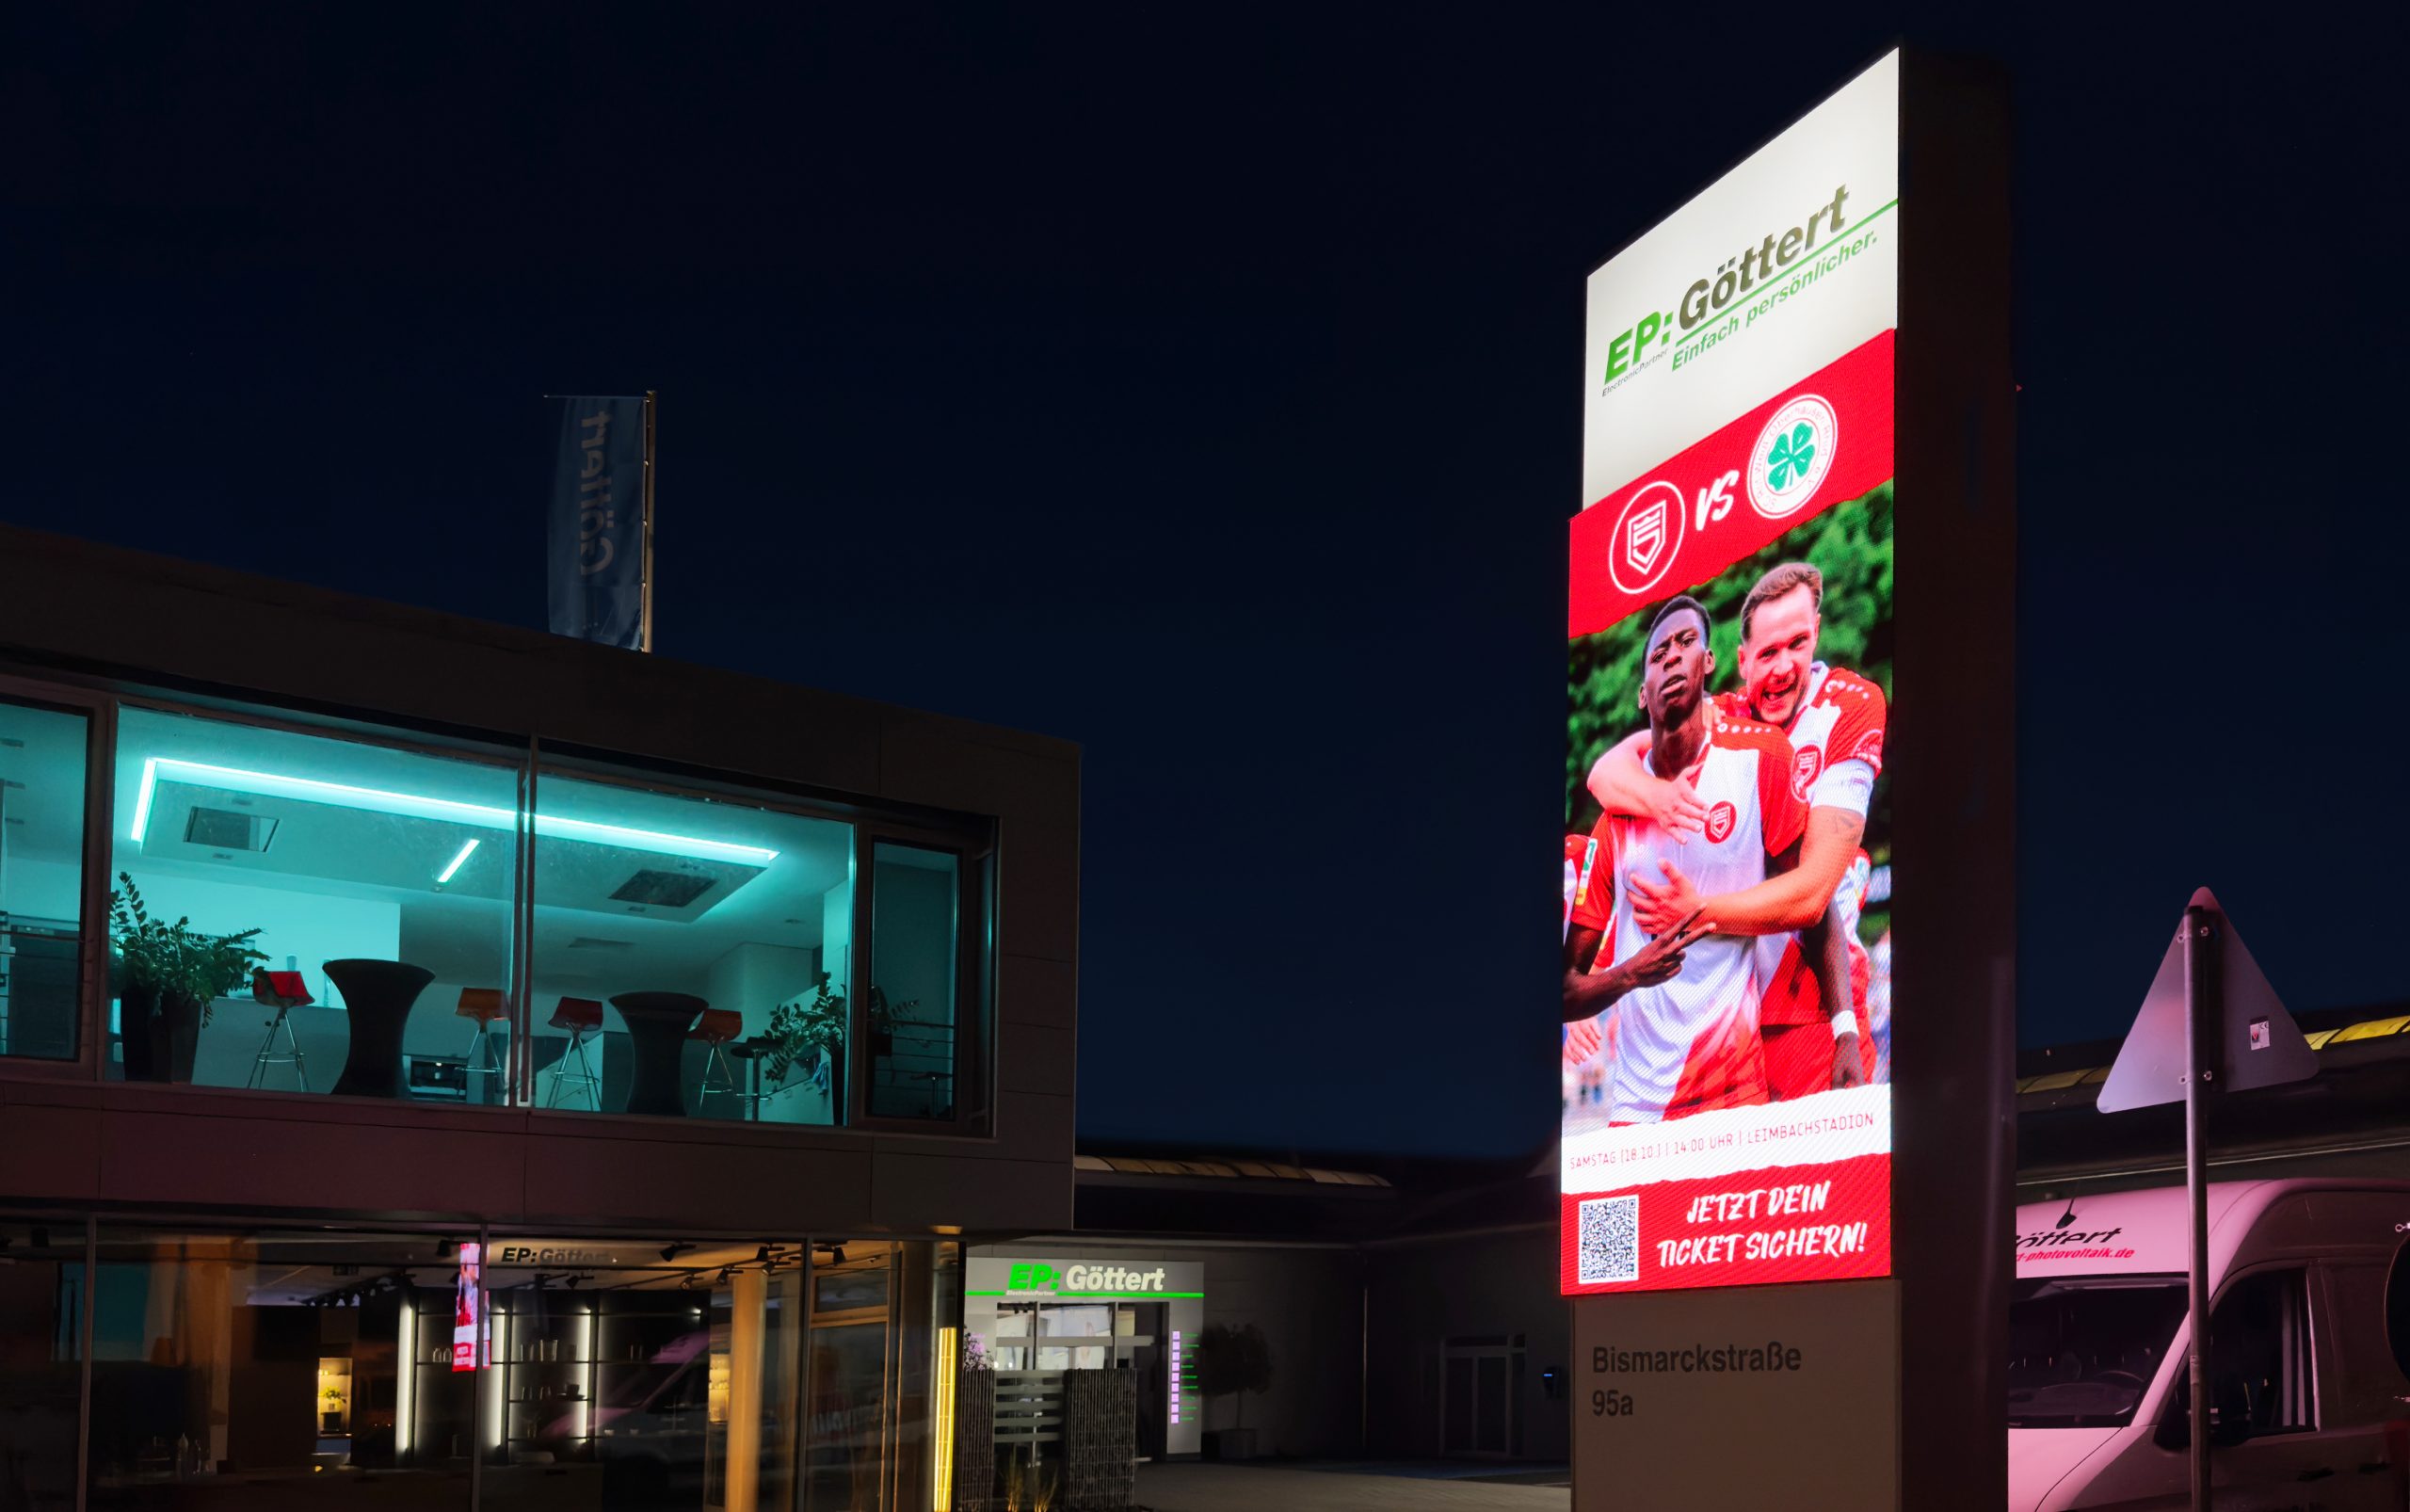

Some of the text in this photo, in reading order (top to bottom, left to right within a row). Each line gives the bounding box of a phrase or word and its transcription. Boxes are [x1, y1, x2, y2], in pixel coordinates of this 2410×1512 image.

[1679, 184, 1850, 330] Göttert
[1672, 231, 1878, 372] Einfach persönlicher.
[1602, 348, 1668, 397] ElectronicPartner
[1695, 469, 1740, 531] VS
[1569, 1151, 1616, 1170] SAMSTAG
[1710, 1134, 1733, 1150] UHR
[1747, 1113, 1874, 1144] LEIMBACHSTADION
[1686, 1181, 1831, 1224] JETZT DEIN
[1657, 1222, 1868, 1268] TICKET SICHERN!
[2016, 1228, 2122, 1248] öttert
[1008, 1263, 1165, 1292] EP: Göttert
[1592, 1342, 1802, 1375] Bismarckstraße
[1592, 1390, 1633, 1417] 95a
